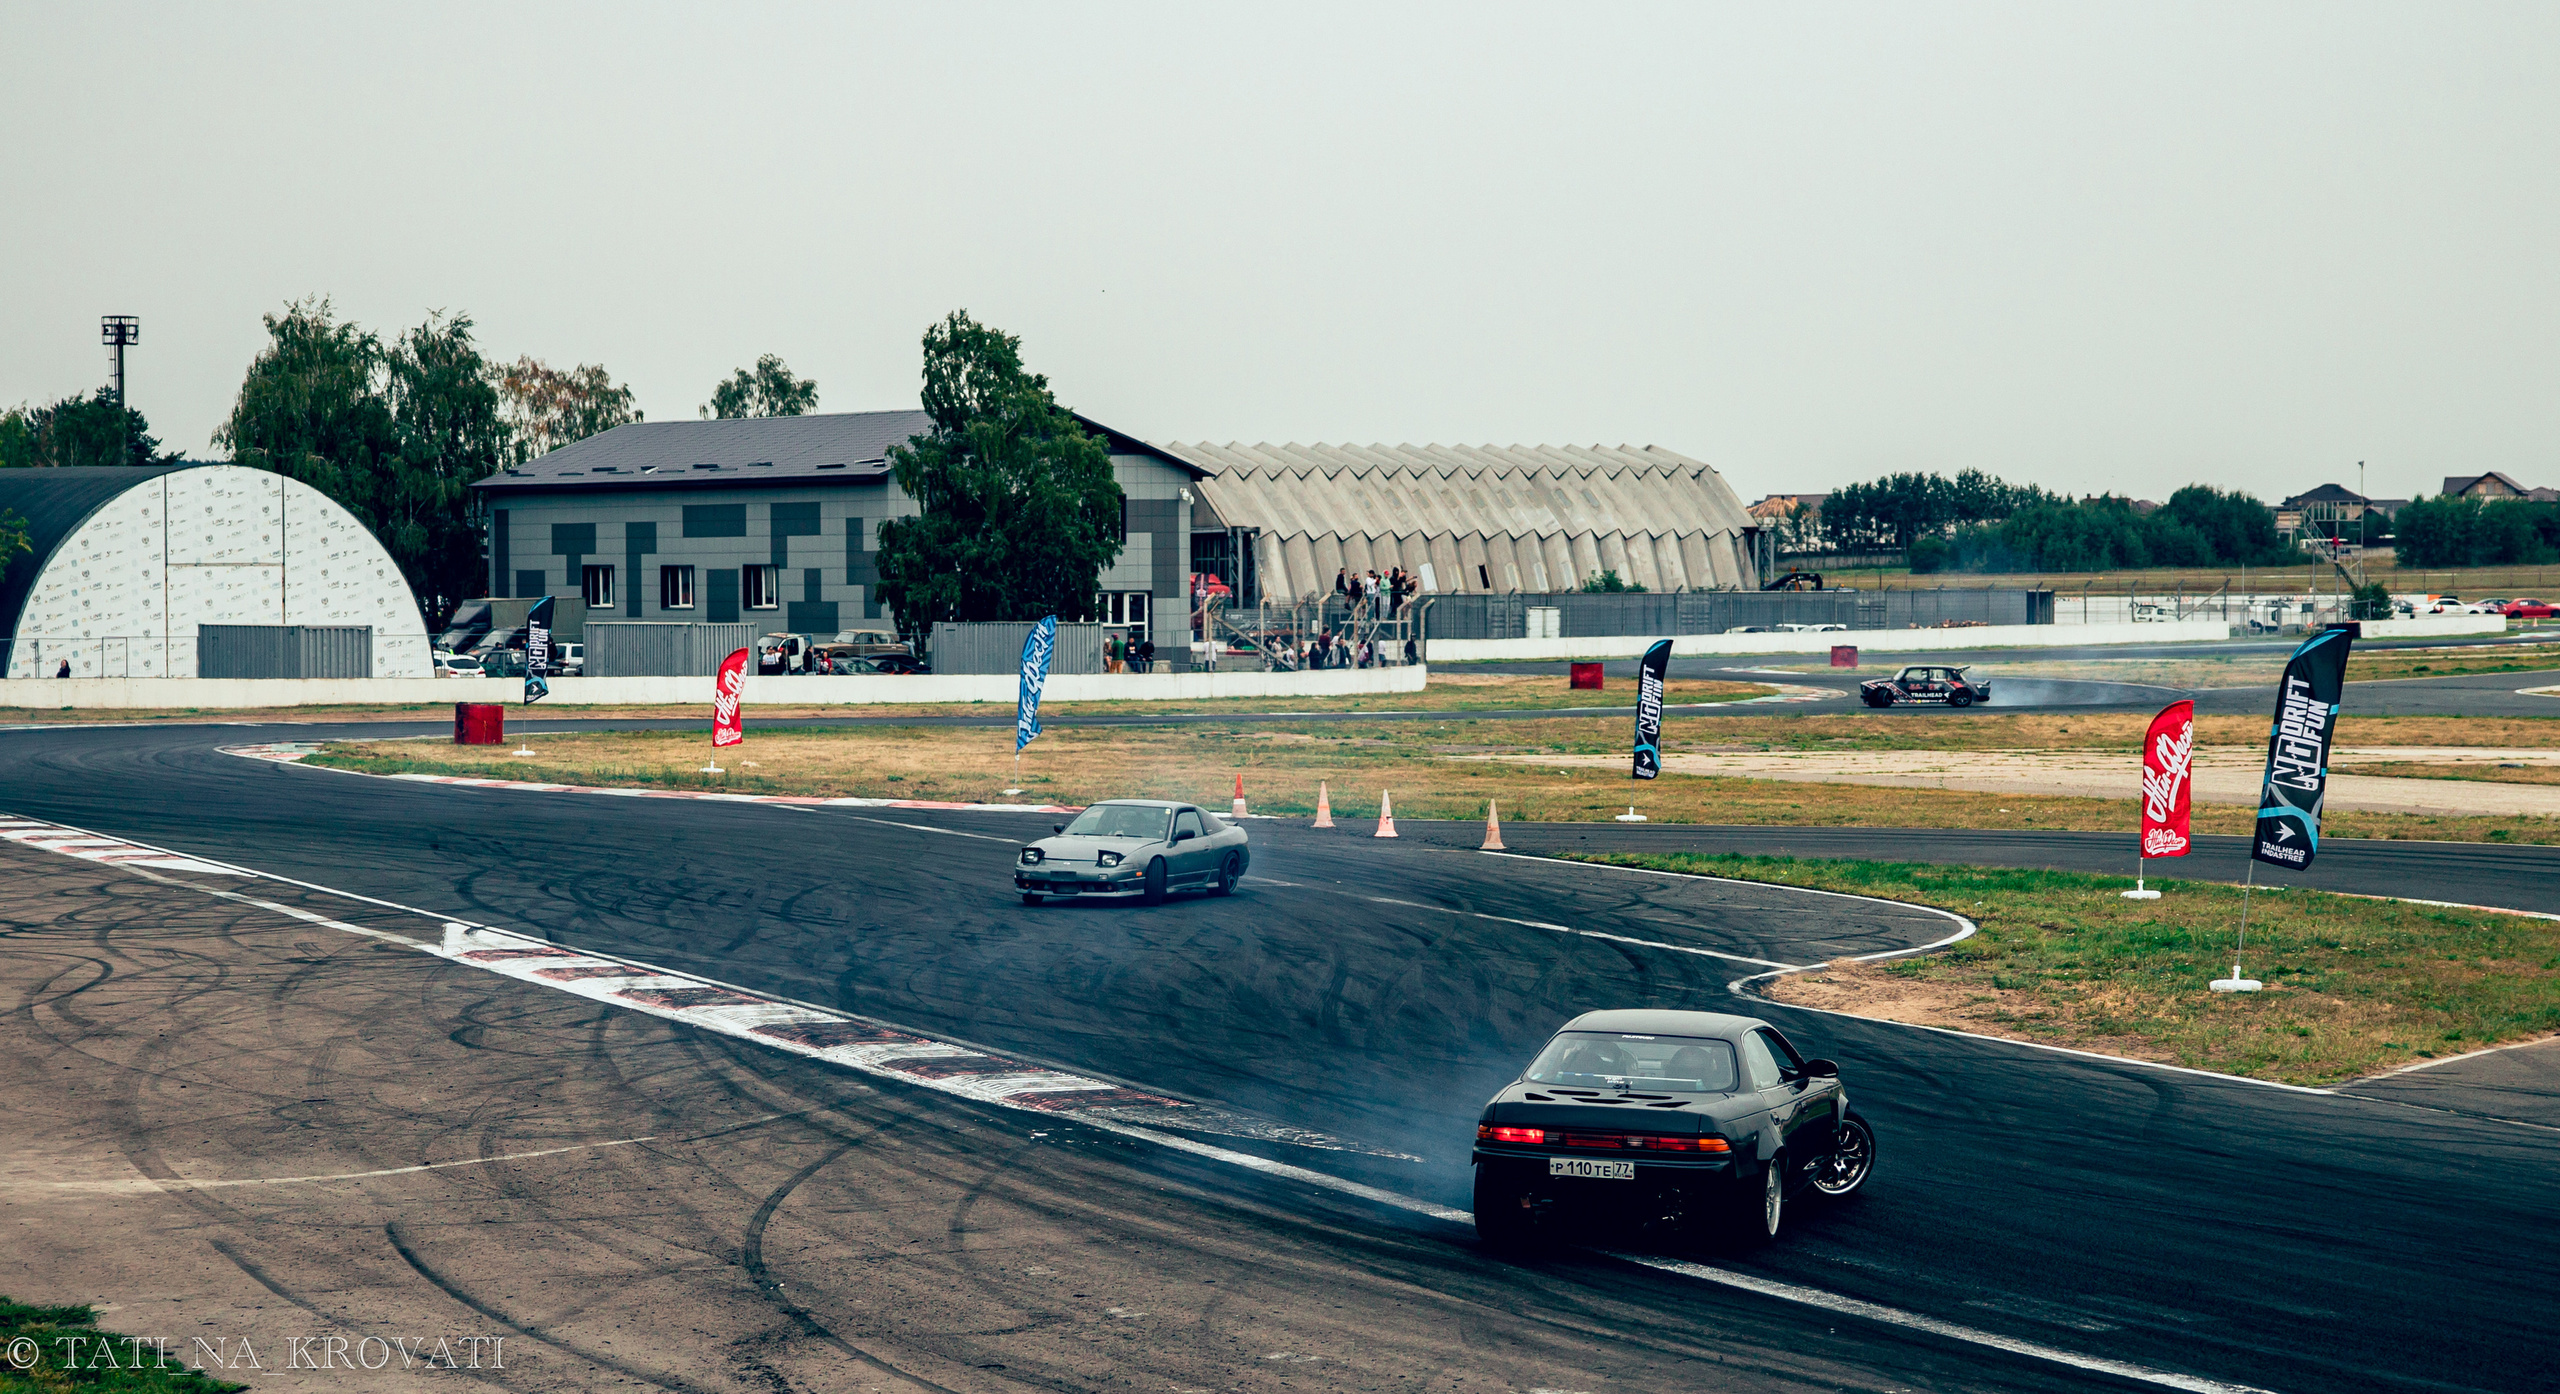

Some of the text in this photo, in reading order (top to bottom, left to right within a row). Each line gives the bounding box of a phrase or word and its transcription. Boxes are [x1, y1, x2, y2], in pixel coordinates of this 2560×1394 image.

[529, 619, 540, 647] DRIFT
[538, 628, 549, 647] FUN
[1641, 664, 1655, 703] DRIFT
[2280, 675, 2310, 737] DRIFT
[2303, 699, 2330, 742] FUN
[2261, 848, 2304, 863] INDASTREE
[2262, 841, 2306, 856] TRAILHEAD
[1615, 1163, 1629, 1174] 77
